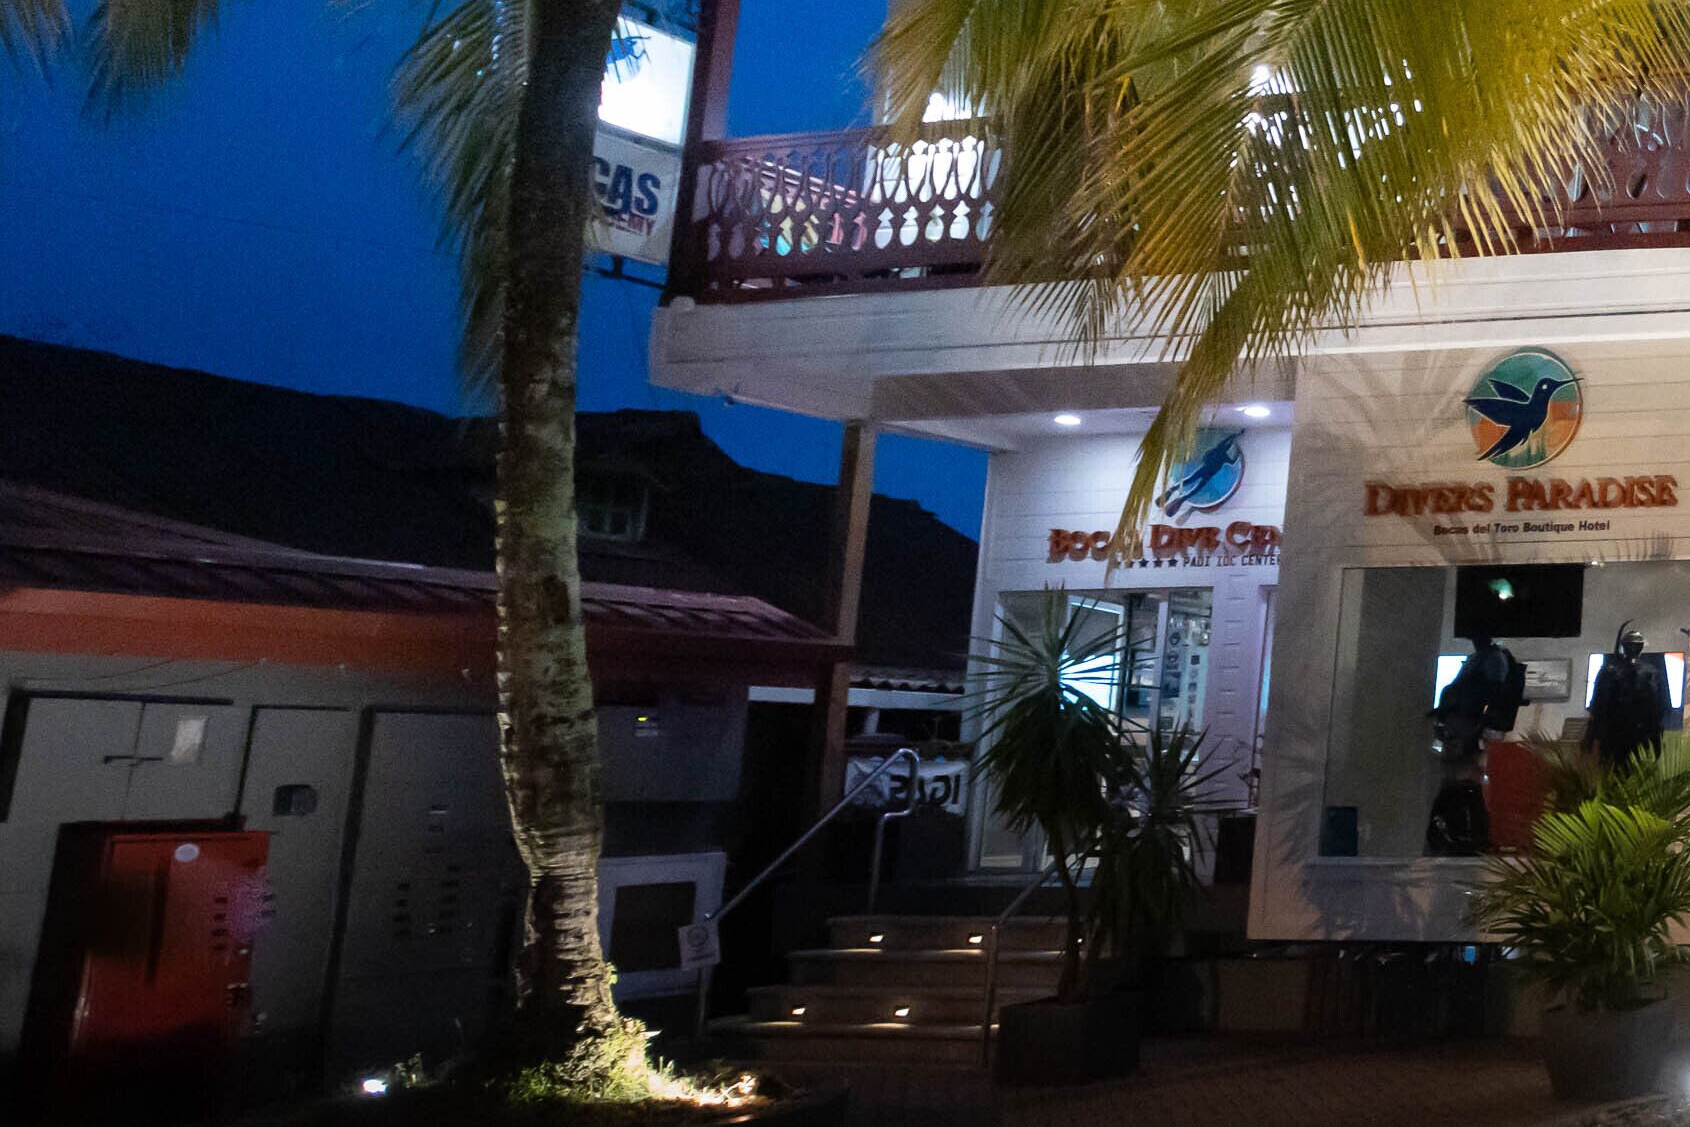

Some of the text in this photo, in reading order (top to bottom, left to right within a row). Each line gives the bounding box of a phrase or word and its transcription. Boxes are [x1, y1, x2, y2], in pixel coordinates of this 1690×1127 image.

[1364, 474, 1679, 517] DIVERS PARADISE
[1433, 519, 1611, 536] Bocas del Toro Boutique Hotel
[1183, 555, 1210, 568] PADI
